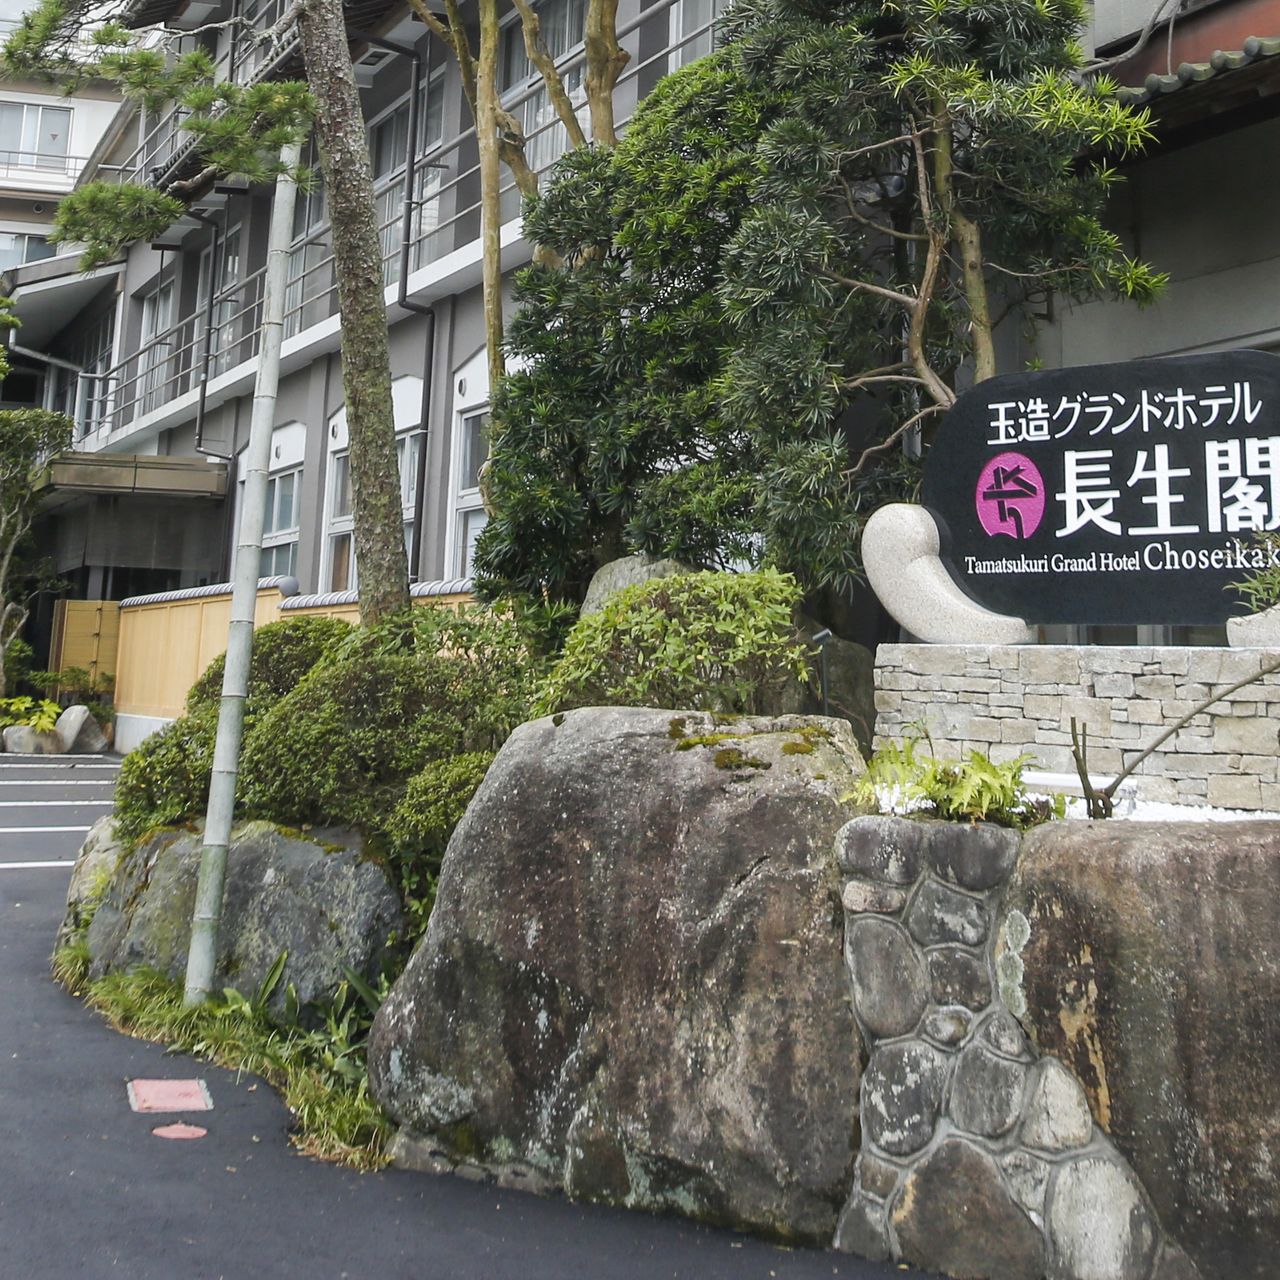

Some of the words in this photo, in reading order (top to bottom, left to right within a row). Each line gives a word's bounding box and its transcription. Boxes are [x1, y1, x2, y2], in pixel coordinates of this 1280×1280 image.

[986, 381, 1263, 445] 玉造グランドホテル
[964, 554, 1049, 574] Tamatsukuri
[1050, 552, 1097, 572] Grand
[1099, 550, 1141, 571] Hotel
